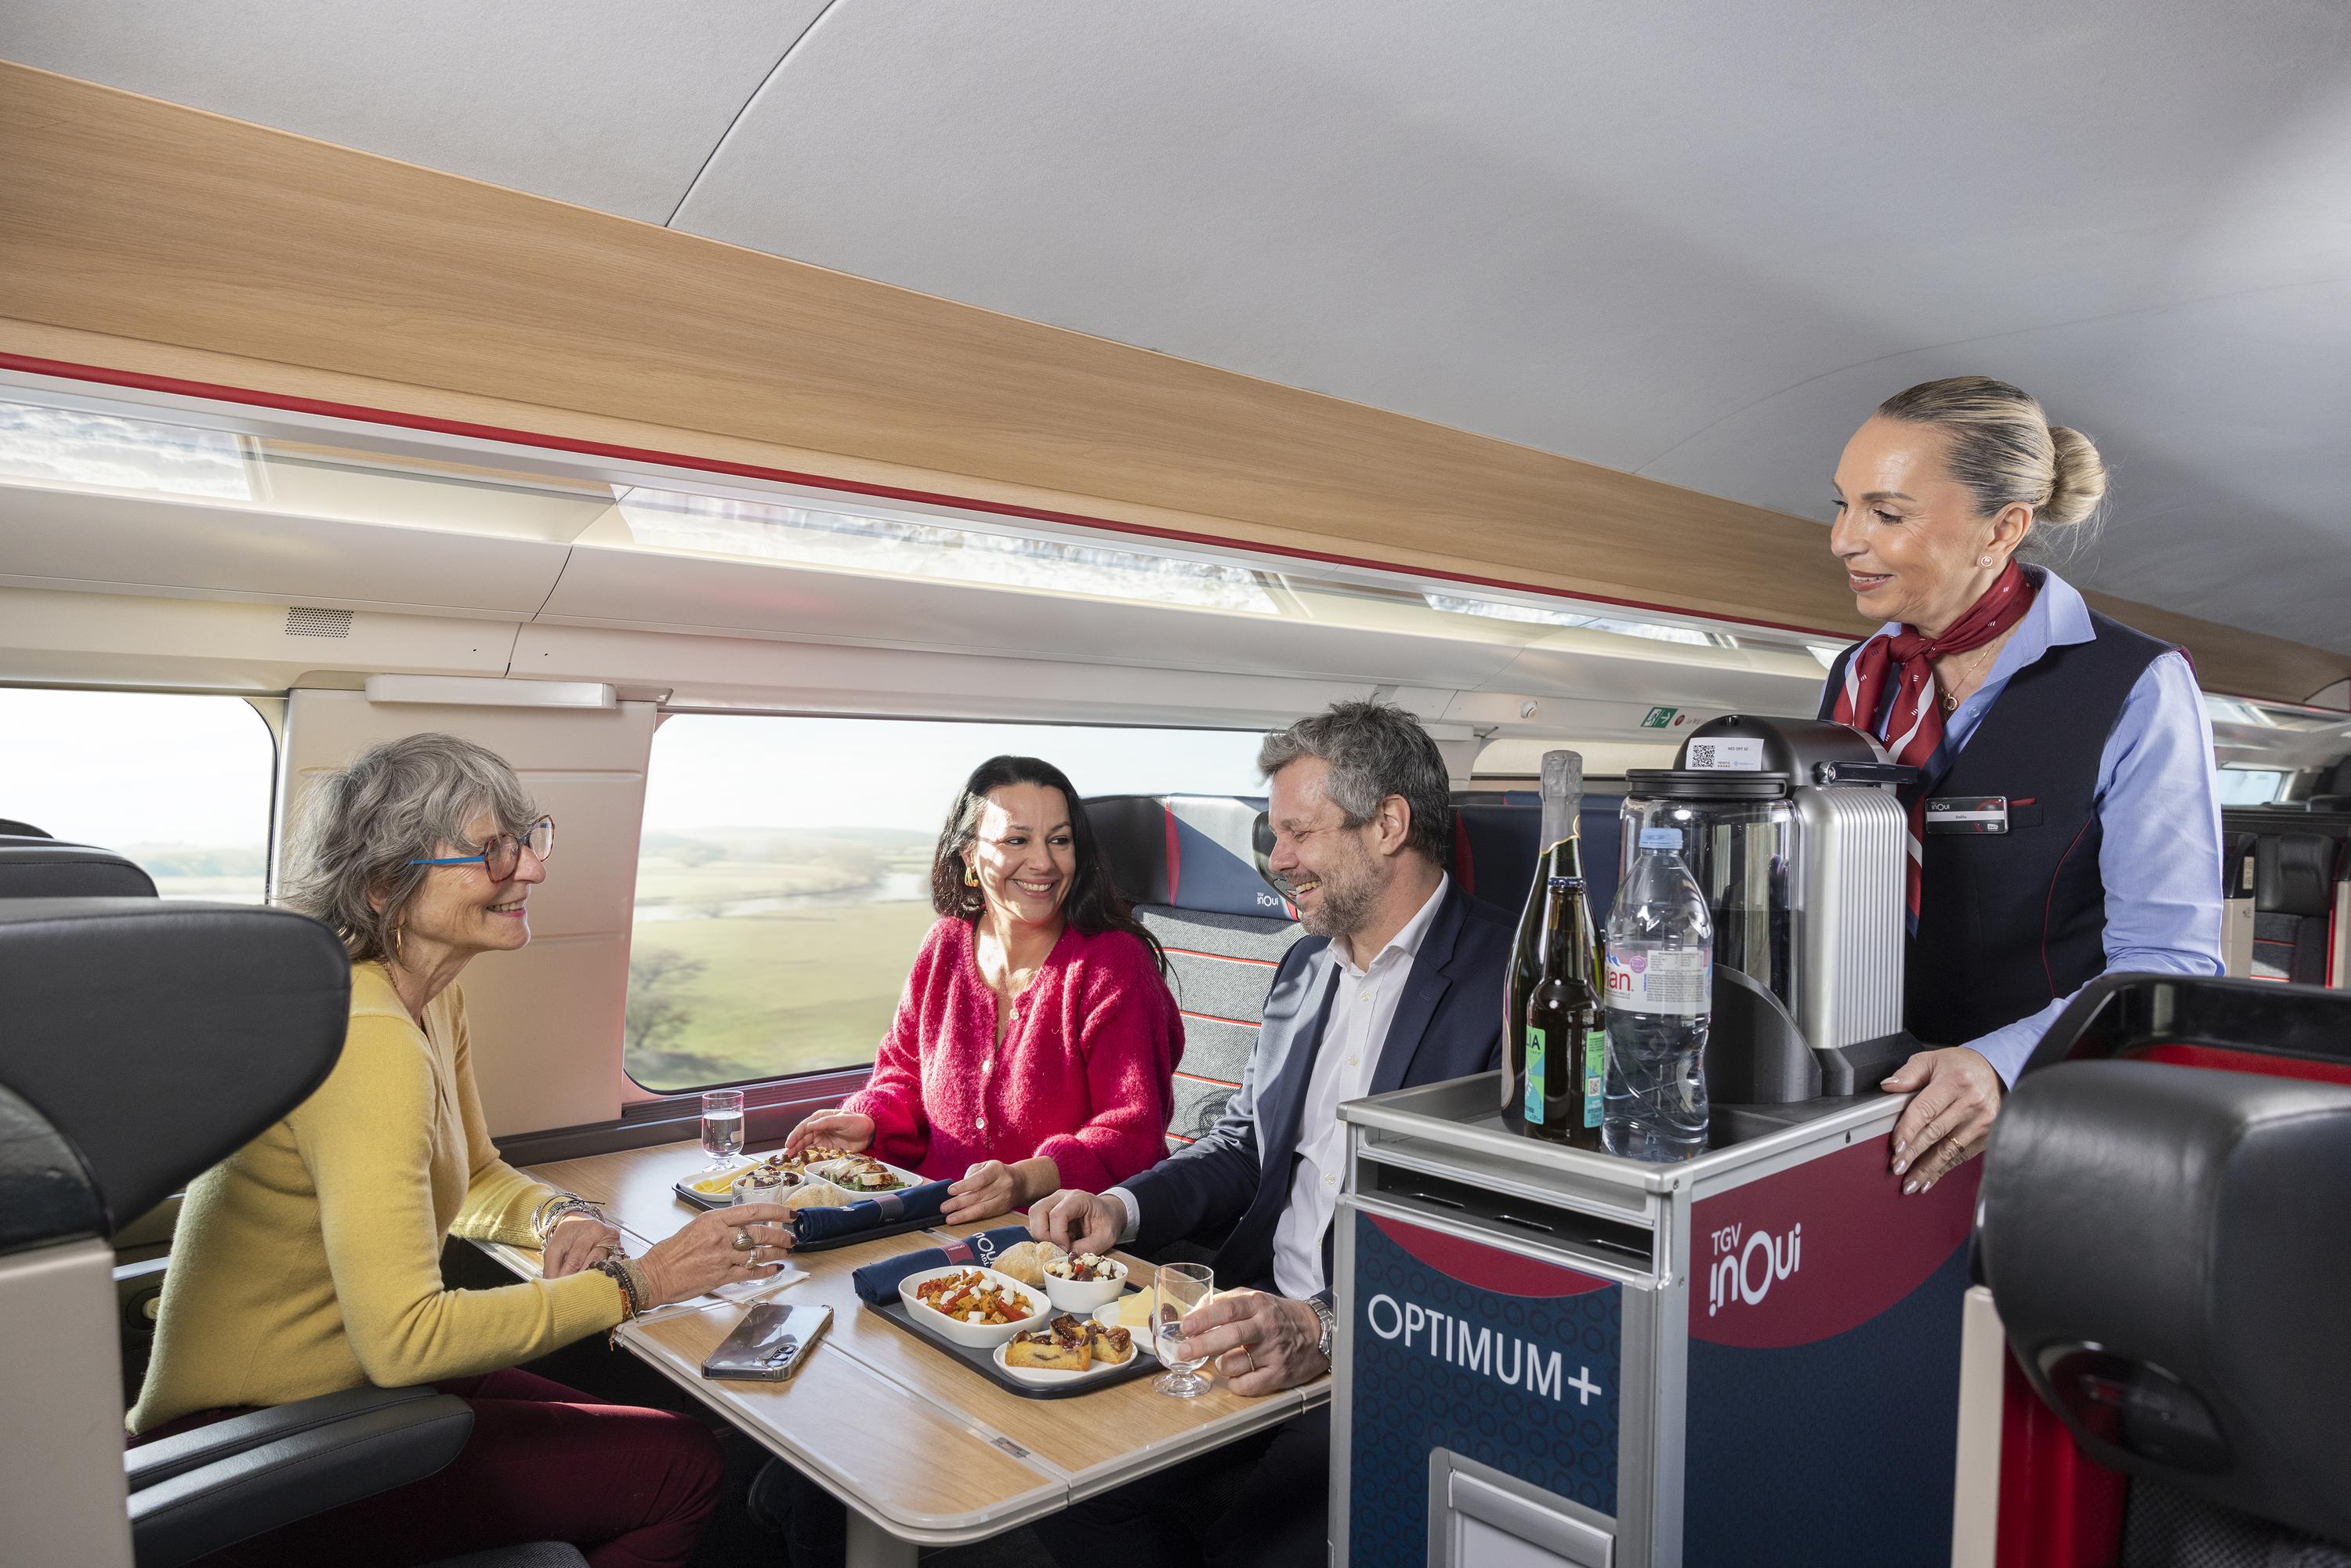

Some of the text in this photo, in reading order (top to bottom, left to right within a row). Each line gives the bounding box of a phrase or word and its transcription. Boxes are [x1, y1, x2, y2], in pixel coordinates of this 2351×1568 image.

[1257, 896, 1279, 907] inOui
[1605, 966, 1631, 991] ian
[973, 1232, 998, 1264] nOu
[1712, 1222, 1741, 1255] TGV
[980, 1254, 989, 1266] TGV
[1709, 1222, 1801, 1316] inOui
[1367, 1294, 1602, 1406] OPTIMUM+
